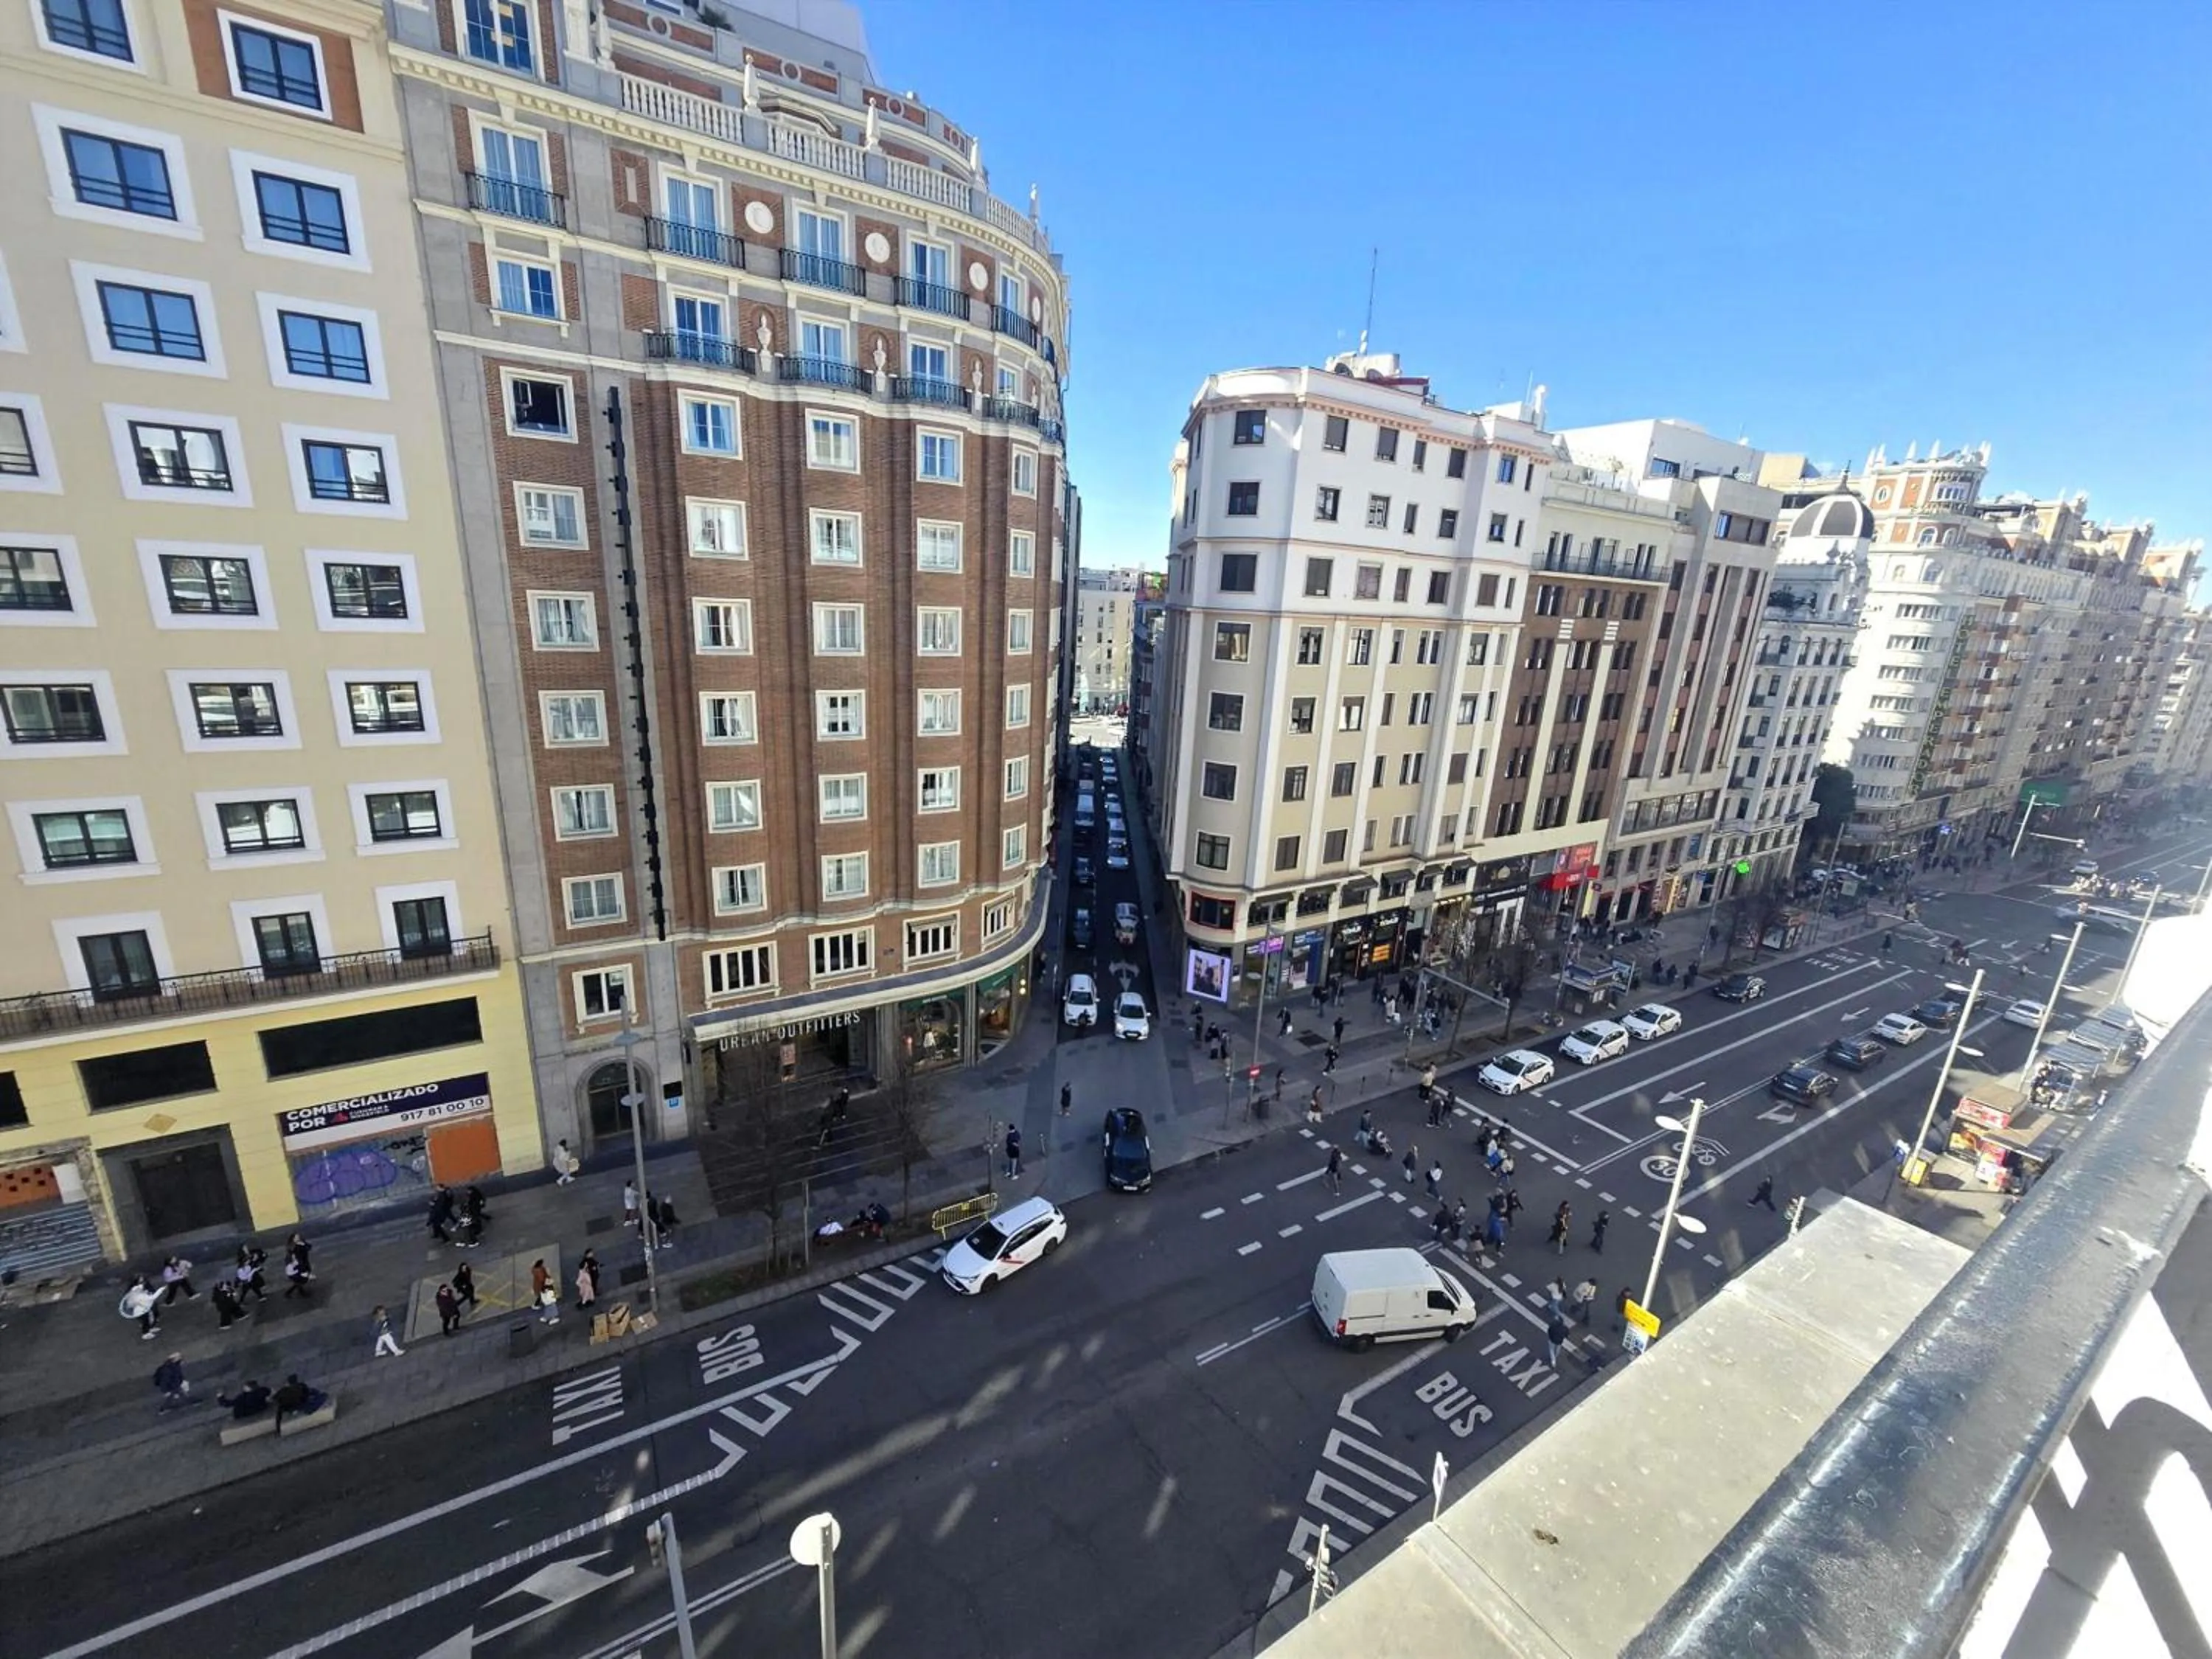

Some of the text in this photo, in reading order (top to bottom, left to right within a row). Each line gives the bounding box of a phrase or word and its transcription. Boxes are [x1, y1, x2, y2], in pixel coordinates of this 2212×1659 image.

[1909, 615, 1974, 796] HOTEL EMPERADOR
[719, 1010, 861, 1052] URBAN OUTFITTERS
[286, 1083, 439, 1121] COMERCIALIZADO
[288, 1116, 327, 1133] POR
[400, 1098, 484, 1121] 917 81 00 10
[1651, 1160, 1679, 1176] 30
[697, 1324, 764, 1385] BUS
[1479, 1329, 1560, 1398] TAXI
[553, 1366, 625, 1445] TAXI
[1415, 1371, 1494, 1438] BUS
